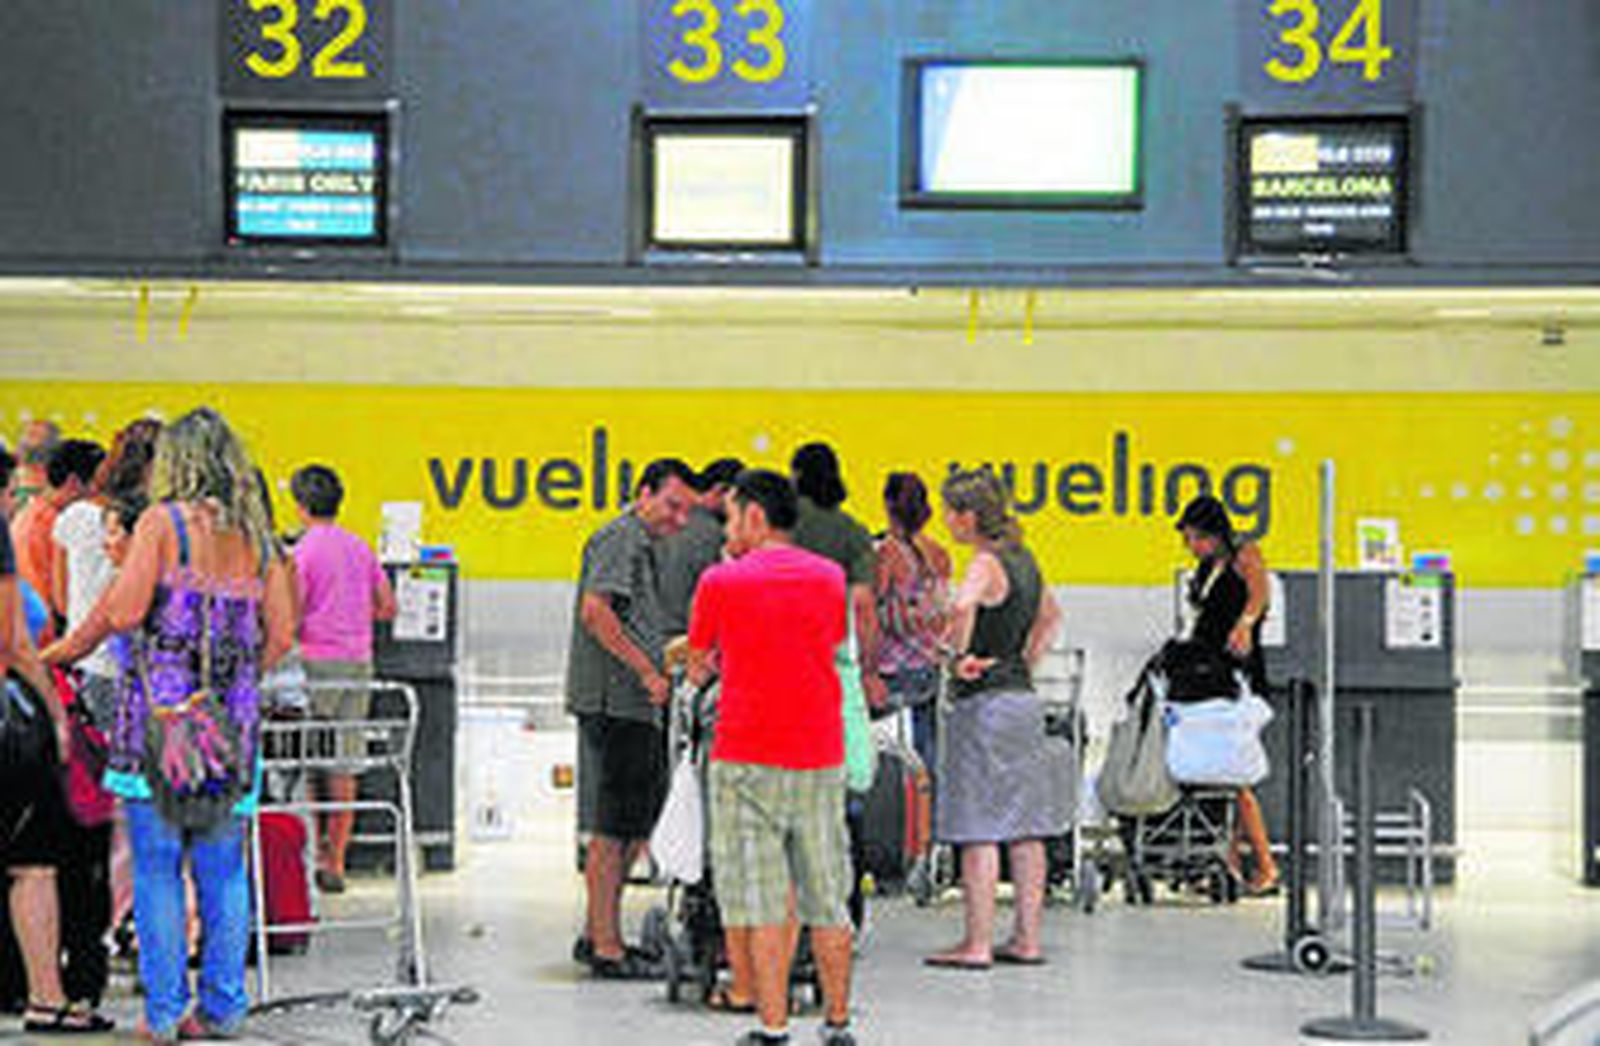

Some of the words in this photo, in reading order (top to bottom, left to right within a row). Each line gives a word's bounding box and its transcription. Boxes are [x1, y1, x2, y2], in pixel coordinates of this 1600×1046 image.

[246, 0, 367, 77] 32
[669, 0, 786, 82] 33
[1264, 0, 1393, 81] 34
[1252, 176, 1391, 197] BARCELONA
[428, 426, 634, 511] vueli
[947, 431, 1271, 540] ueling
